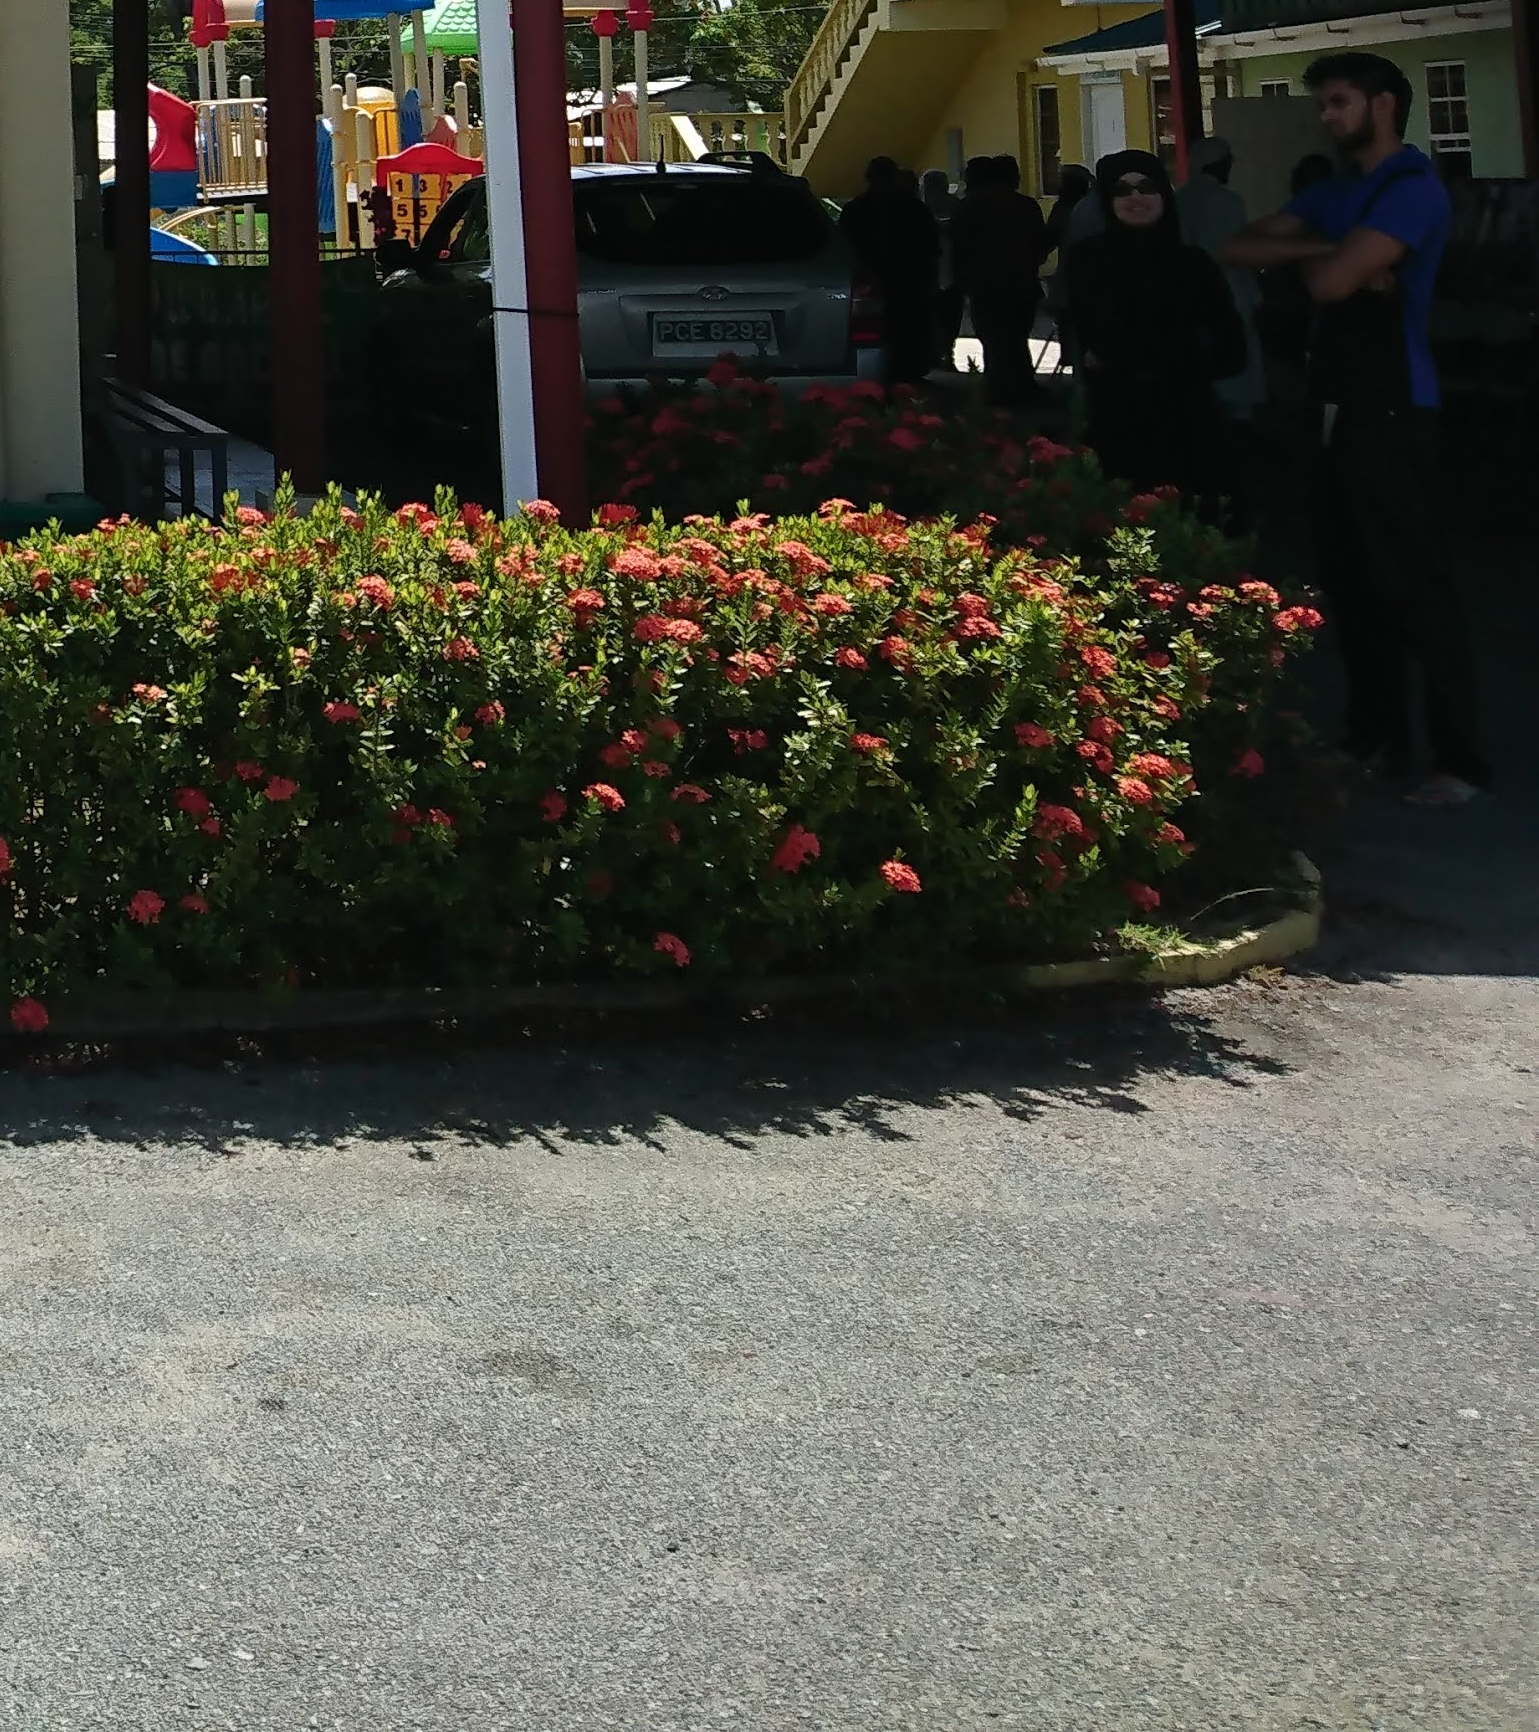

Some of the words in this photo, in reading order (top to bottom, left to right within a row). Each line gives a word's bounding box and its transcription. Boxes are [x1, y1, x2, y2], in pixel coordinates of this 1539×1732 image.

[395, 179, 404, 192] 1
[419, 179, 428, 193] 3
[397, 204, 408, 217] 5
[659, 322, 705, 340] PCE
[709, 322, 769, 340] 8292
